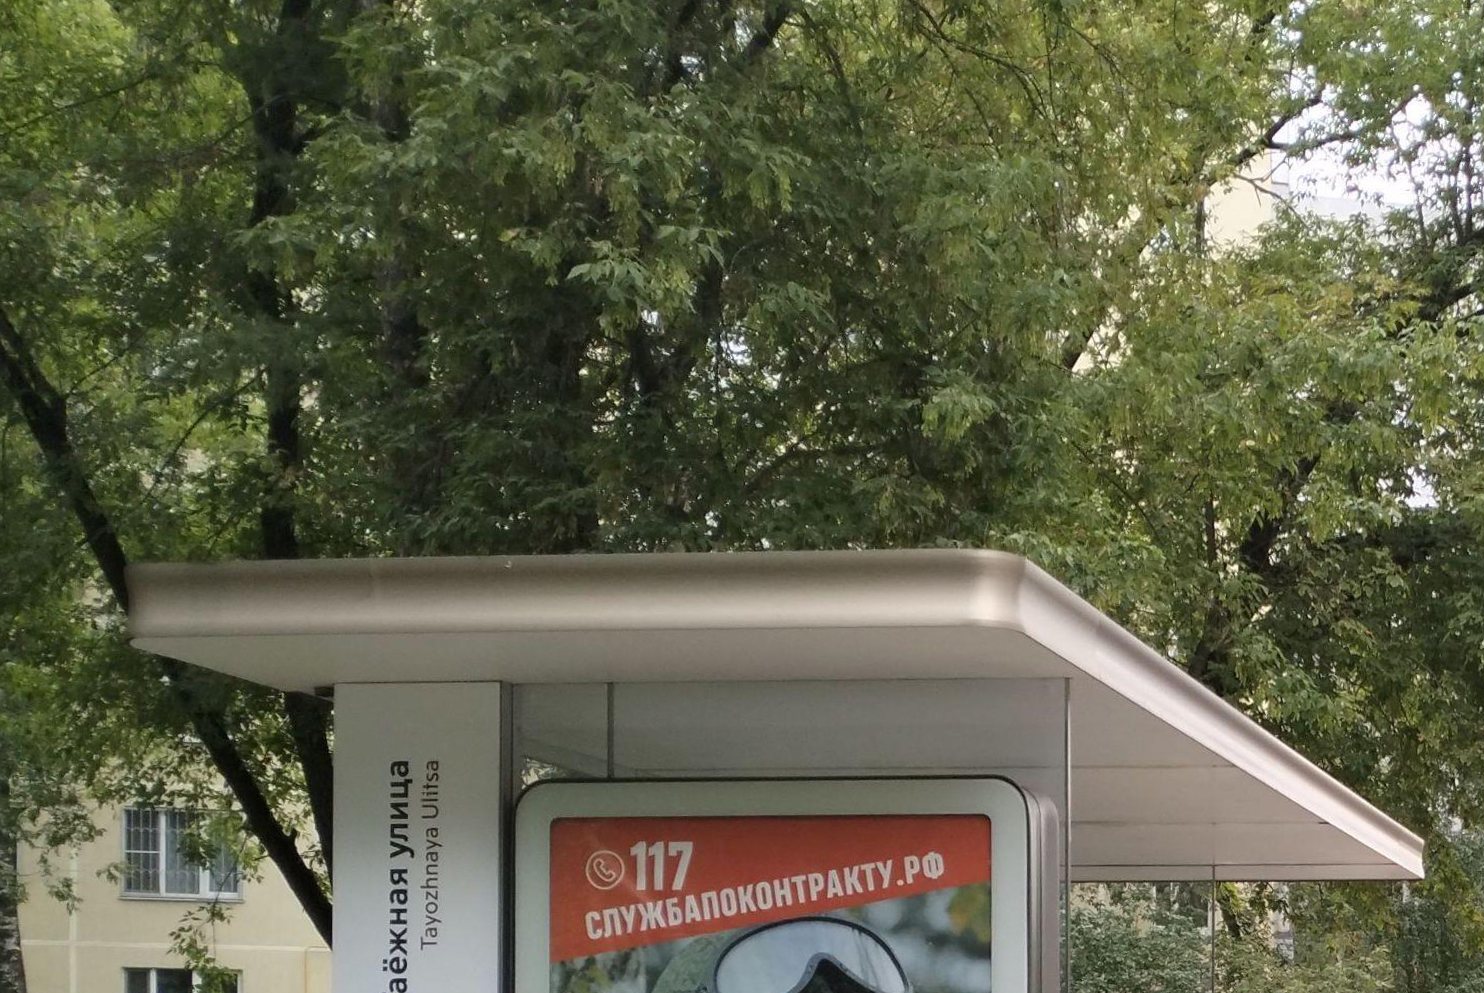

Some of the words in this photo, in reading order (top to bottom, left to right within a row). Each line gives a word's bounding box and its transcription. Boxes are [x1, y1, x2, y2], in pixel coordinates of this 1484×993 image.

[389, 760, 415, 858] улица
[421, 760, 440, 819] Ulitsa
[420, 827, 443, 951] Tayozhnaya
[584, 851, 945, 940] СЛУЖБАПОКОНТРАКТУ.РФ
[630, 840, 694, 892] 117
